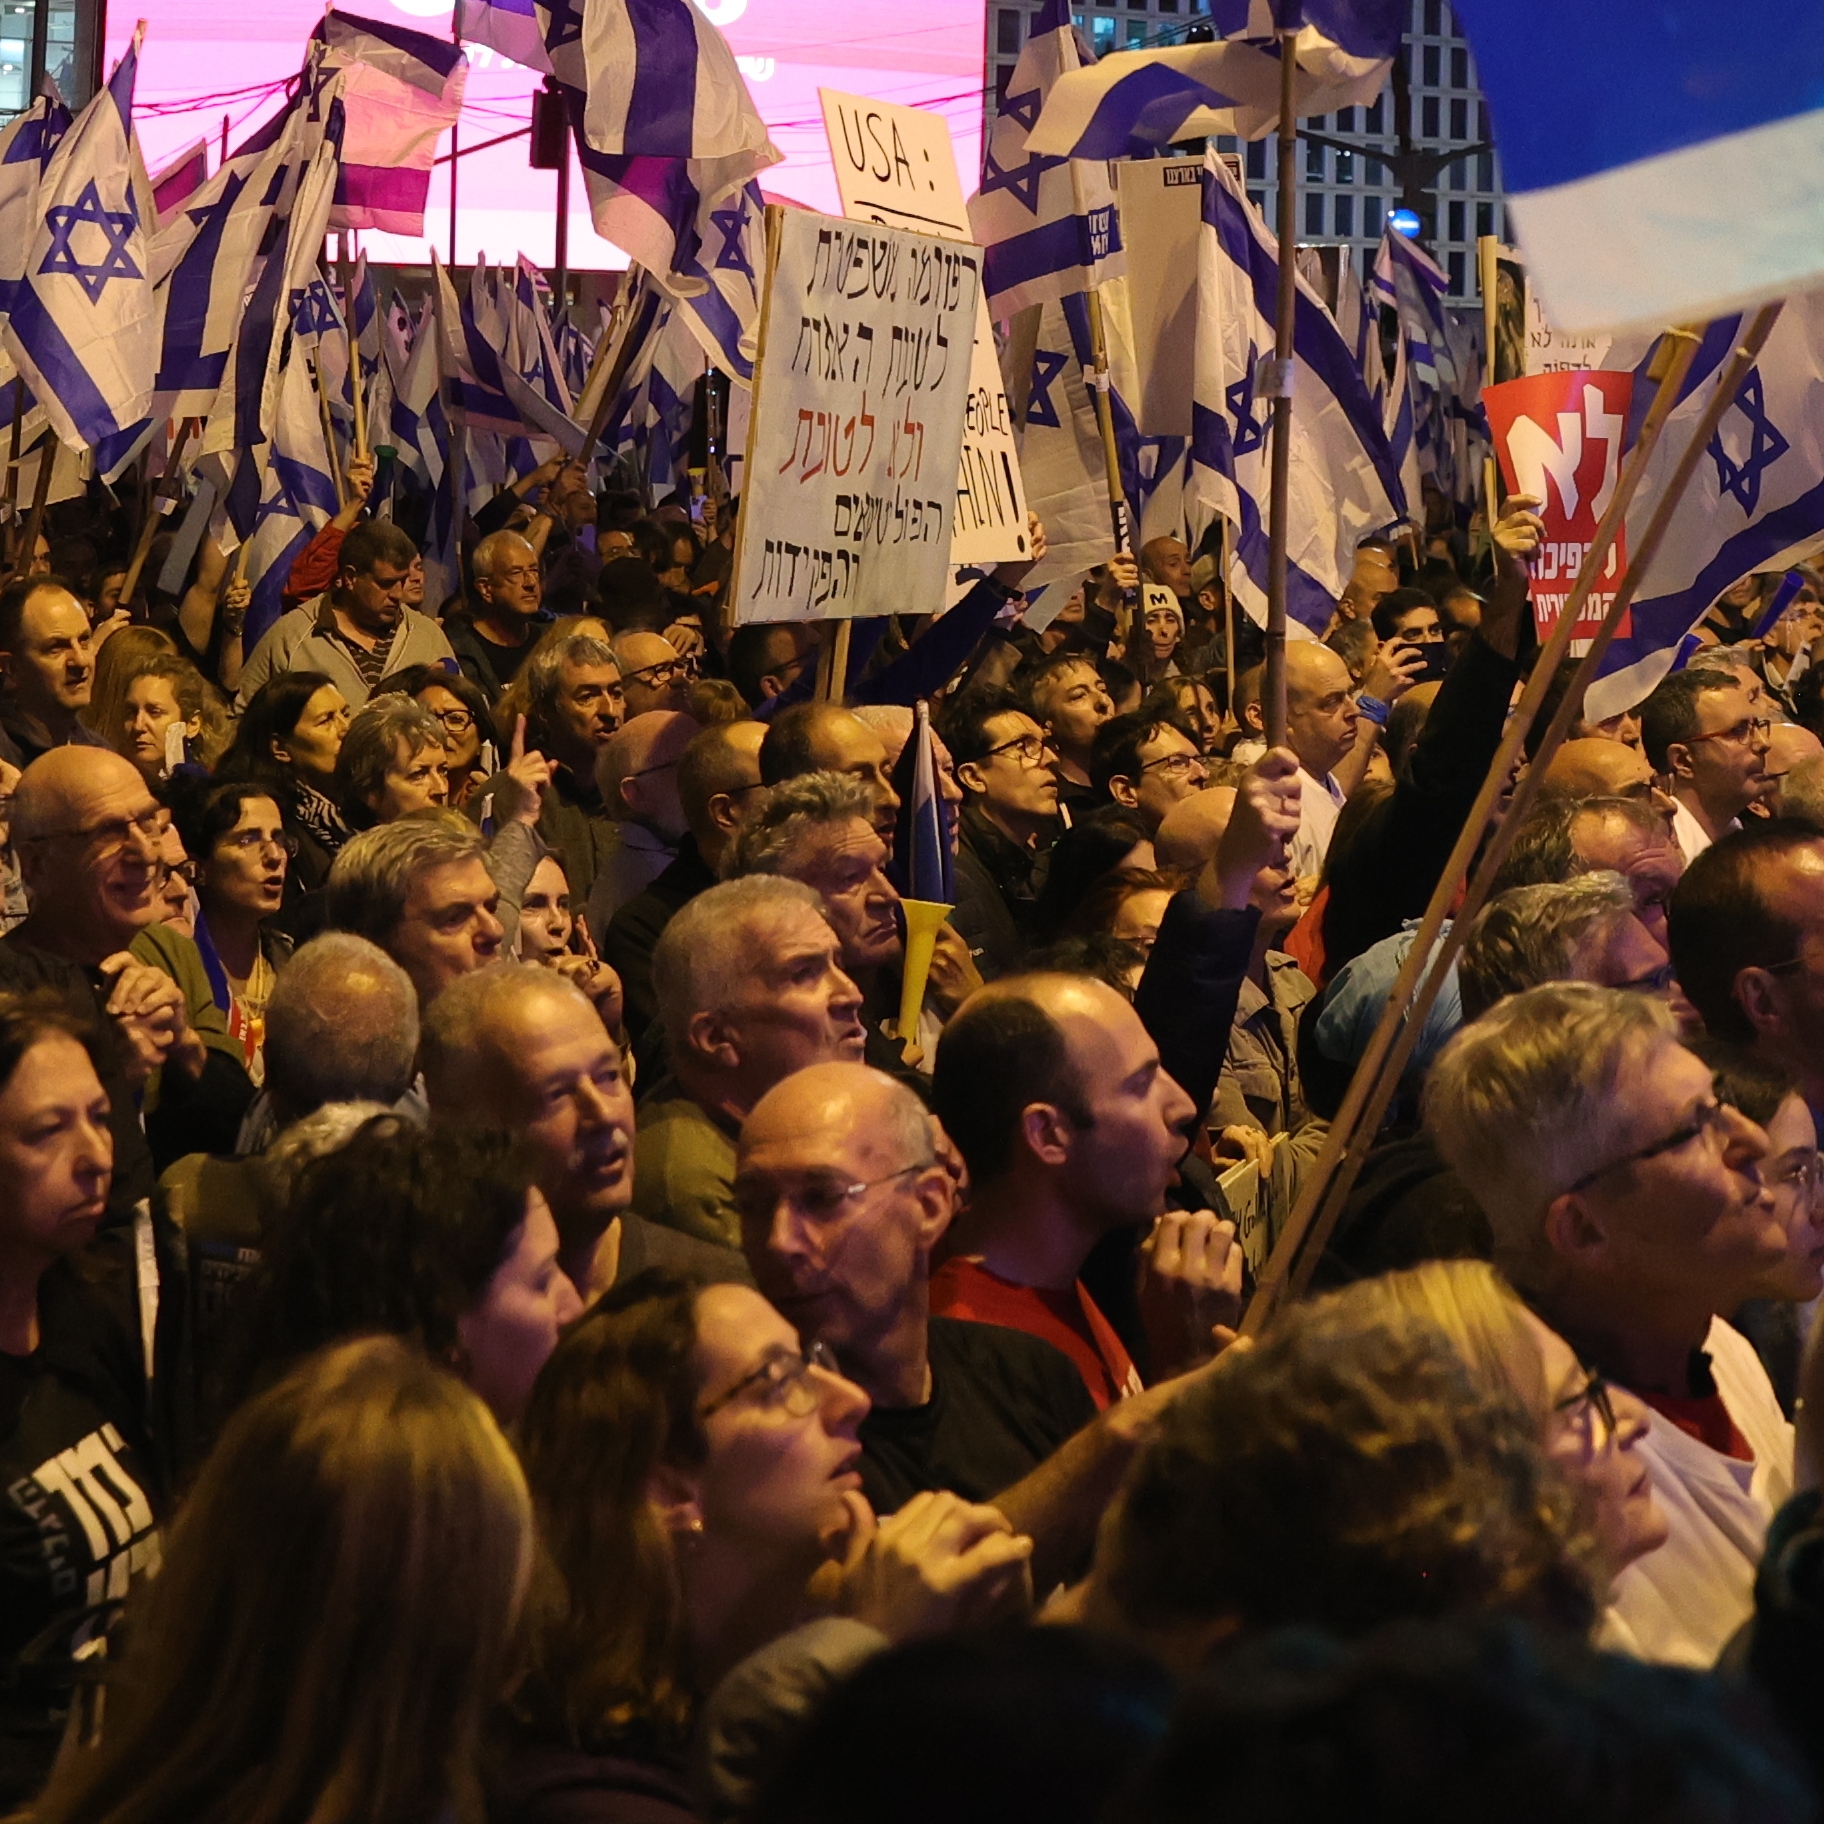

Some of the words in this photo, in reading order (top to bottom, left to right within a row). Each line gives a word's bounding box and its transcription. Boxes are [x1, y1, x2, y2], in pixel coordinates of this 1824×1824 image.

[807, 228, 899, 303] משפטית
[779, 390, 874, 484] לטובת
[959, 389, 1008, 439] EOPLE
[1506, 385, 1624, 527] לא
[1150, 592, 1168, 606] M
